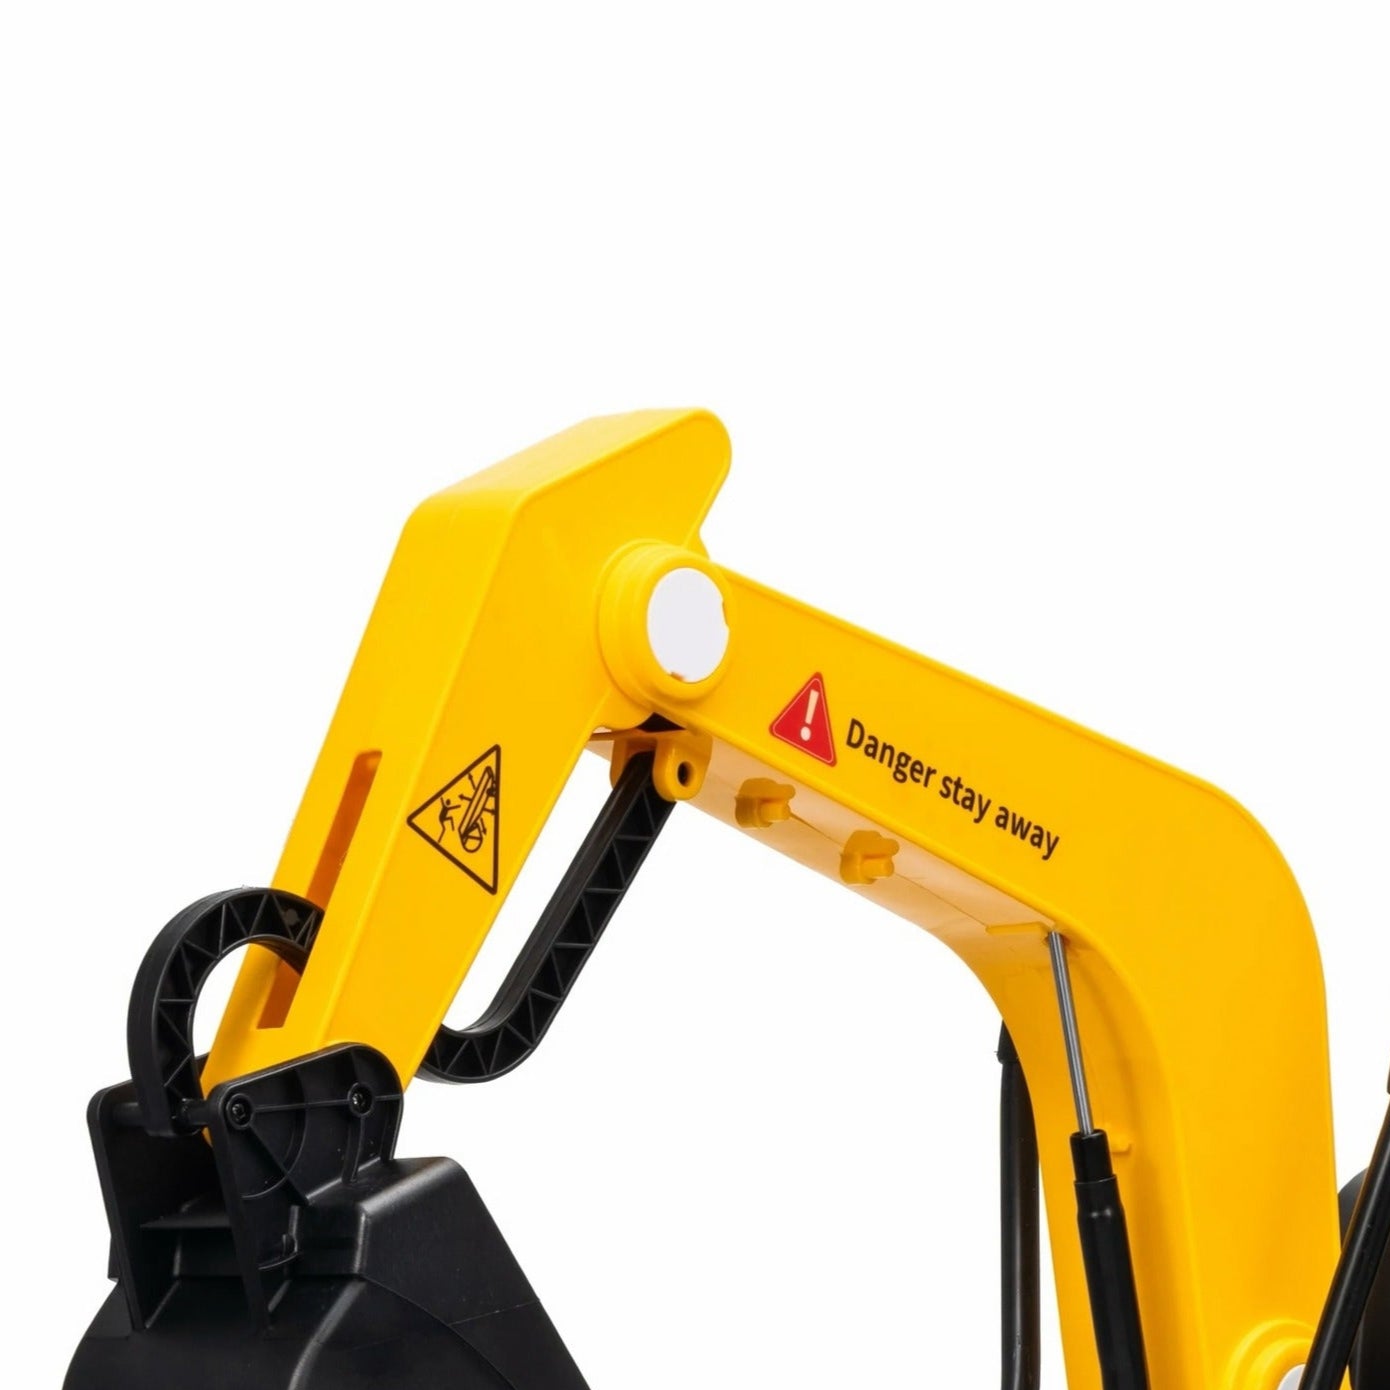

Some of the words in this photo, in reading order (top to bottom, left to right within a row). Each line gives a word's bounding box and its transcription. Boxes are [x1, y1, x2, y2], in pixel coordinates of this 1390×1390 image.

[846, 718, 937, 787] Danger
[939, 774, 991, 824] stay
[994, 806, 1060, 861] away
